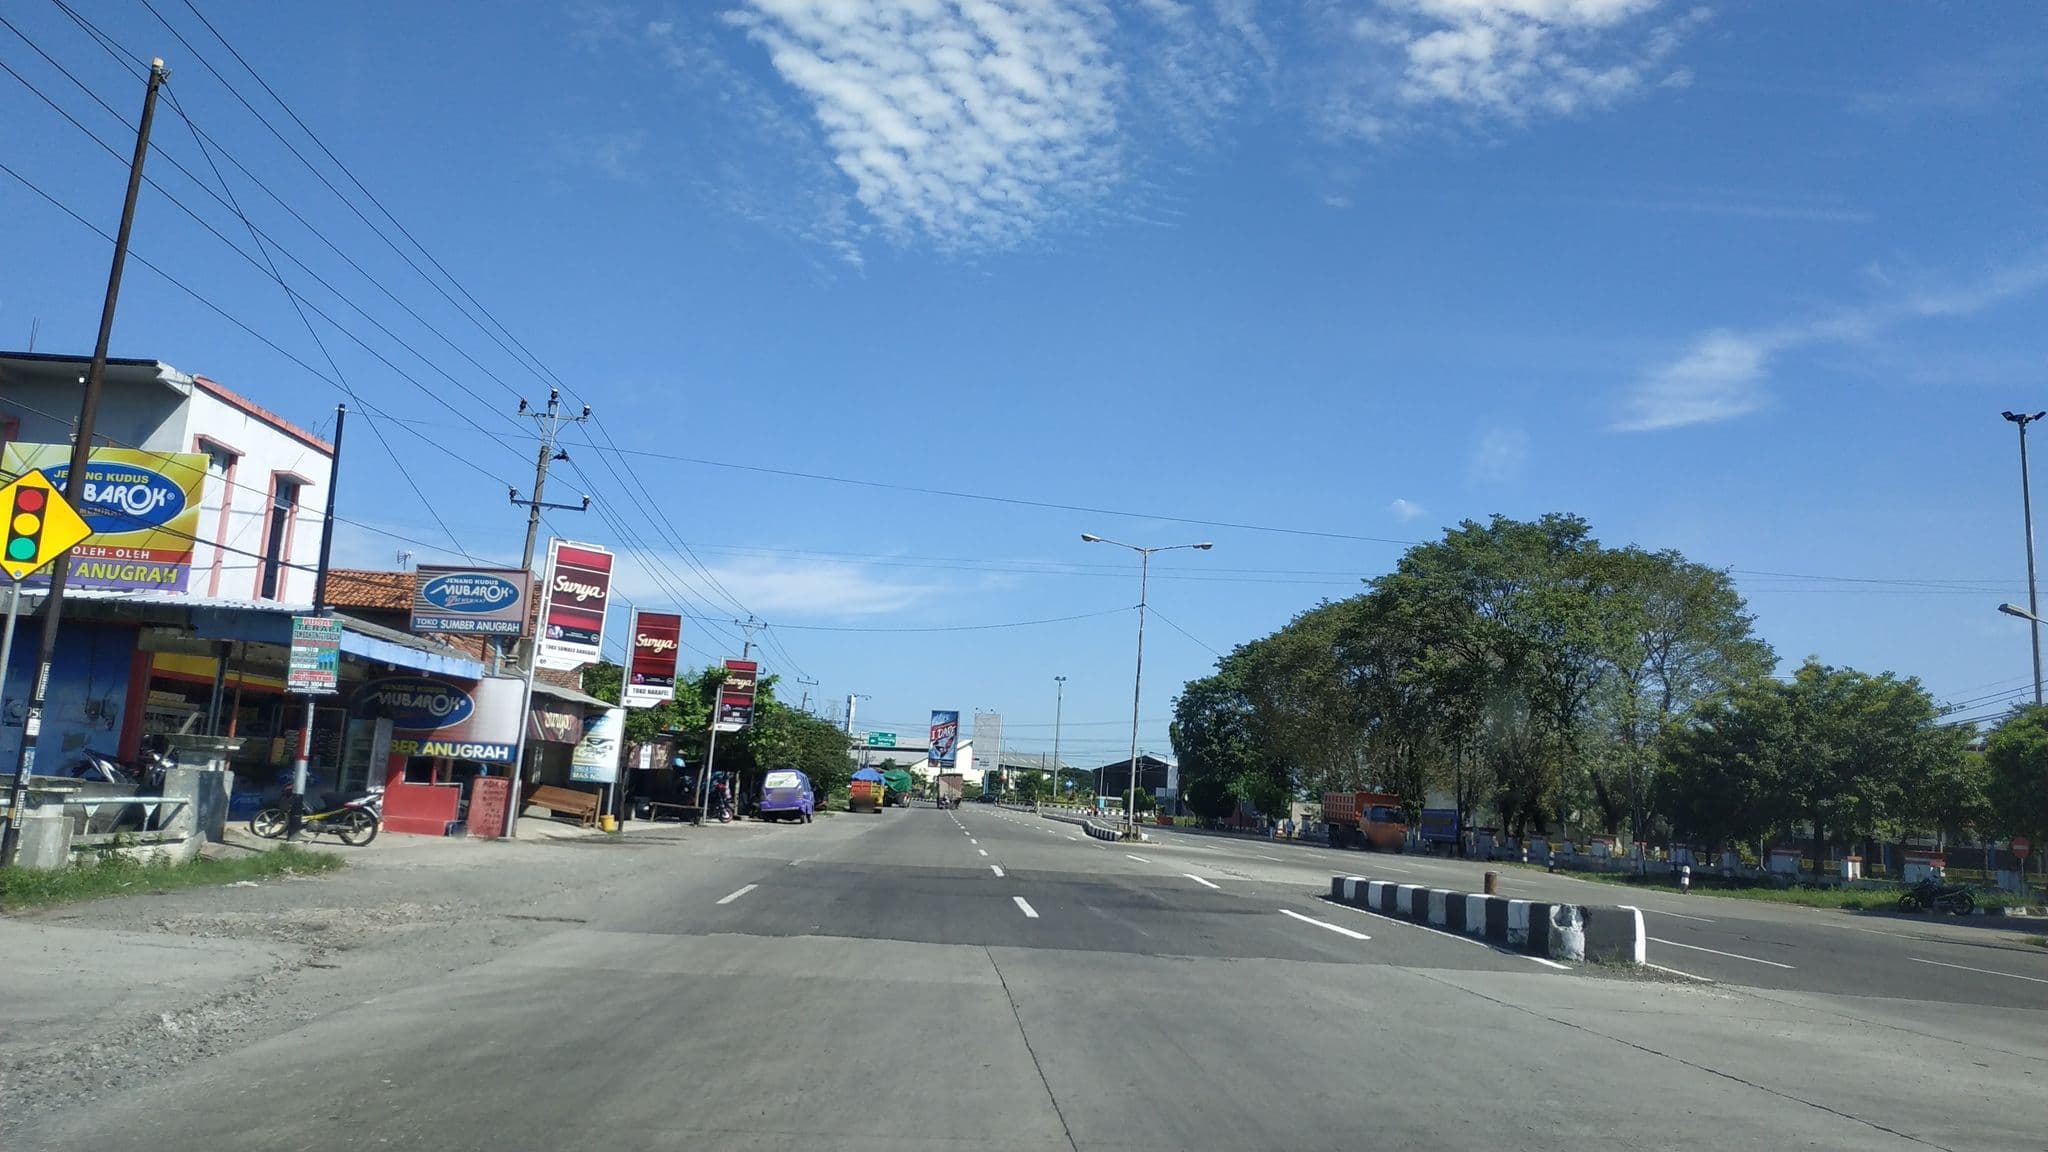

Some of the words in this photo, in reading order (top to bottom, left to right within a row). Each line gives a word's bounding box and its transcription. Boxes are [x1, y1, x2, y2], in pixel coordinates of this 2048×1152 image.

[54, 470, 103, 482] JENG
[106, 473, 149, 484] KUDUS
[72, 546, 106, 556] OLEH
[116, 549, 150, 559] OLEH
[75, 562, 178, 584] ANUGRAH
[429, 584, 510, 602] MUBAROK
[553, 575, 605, 602] Surya
[297, 623, 340, 632] TERAPI
[416, 618, 438, 626] TOKO
[440, 619, 475, 630] SUMBER
[476, 622, 520, 632] ANUGRAH
[635, 633, 678, 653] Surya
[723, 676, 755, 690] Surya
[422, 741, 509, 760] ANUGRAH
